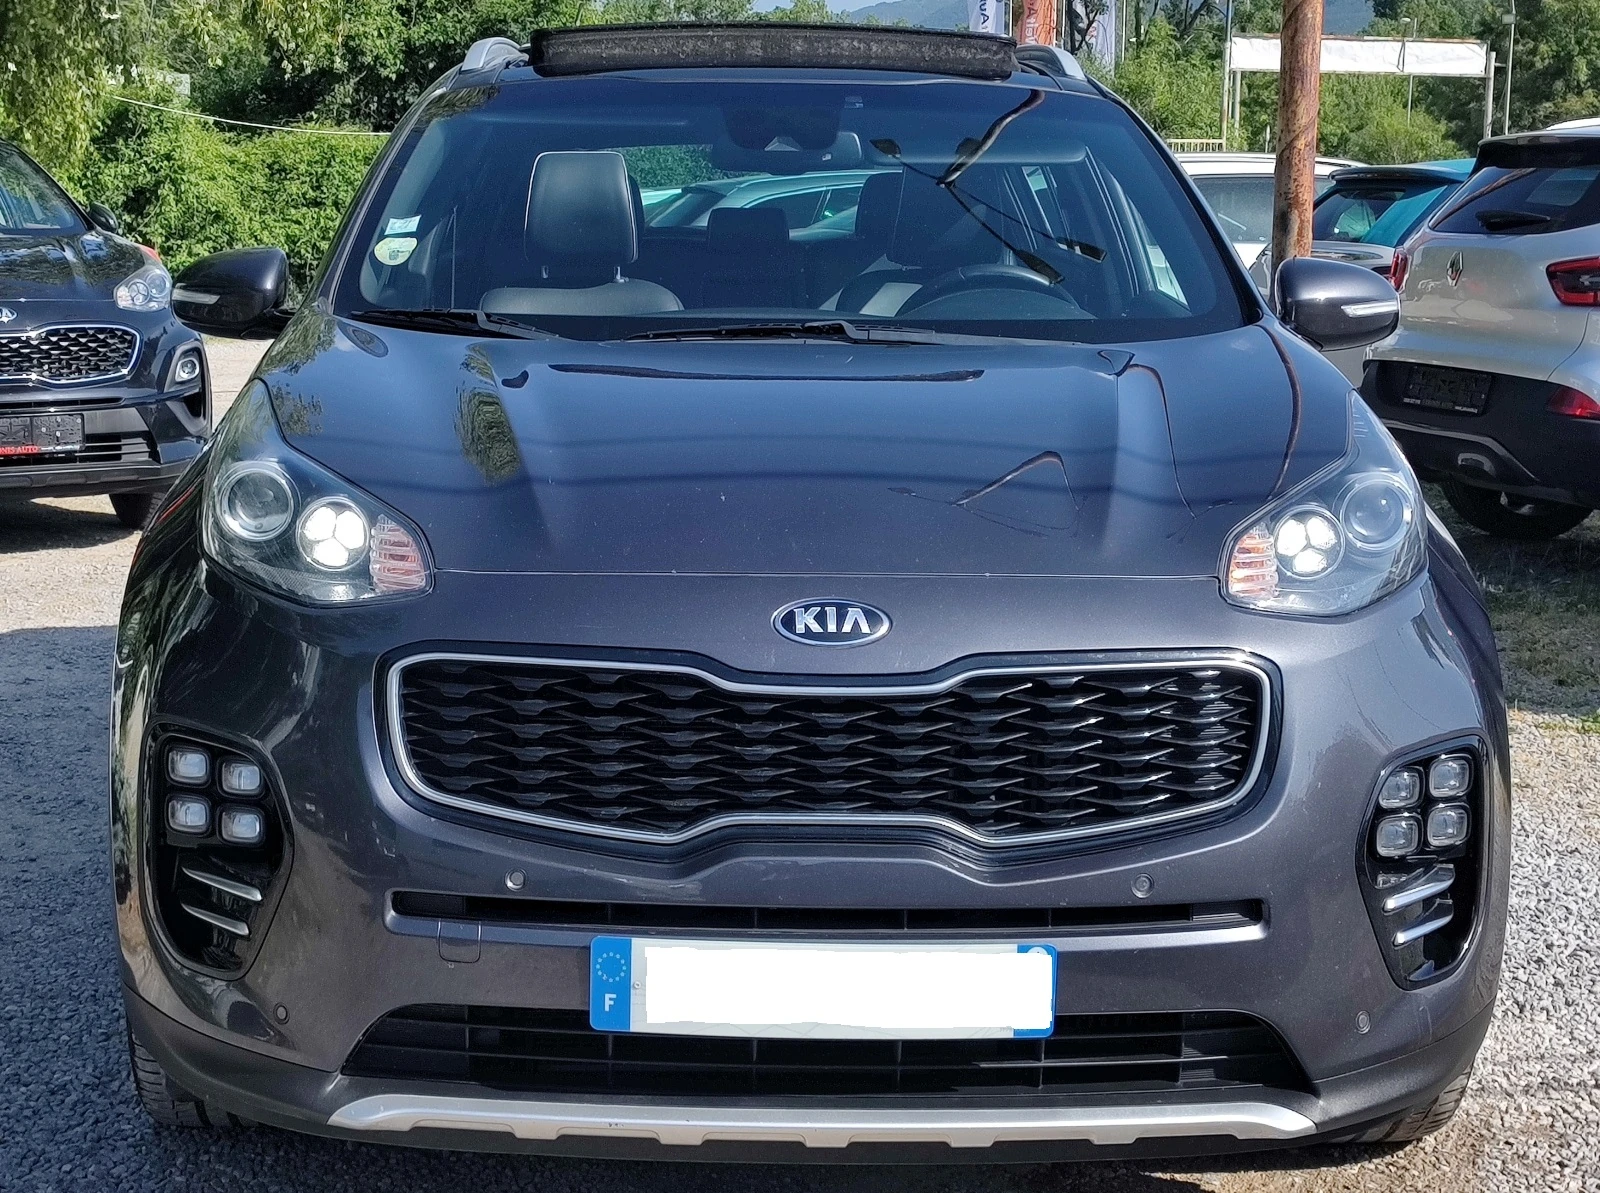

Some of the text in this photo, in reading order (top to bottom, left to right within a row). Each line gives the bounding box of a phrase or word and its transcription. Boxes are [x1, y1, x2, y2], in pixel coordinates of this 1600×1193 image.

[17, 445, 38, 454] AUTO
[794, 606, 872, 633] KIA
[604, 993, 617, 1011] F
